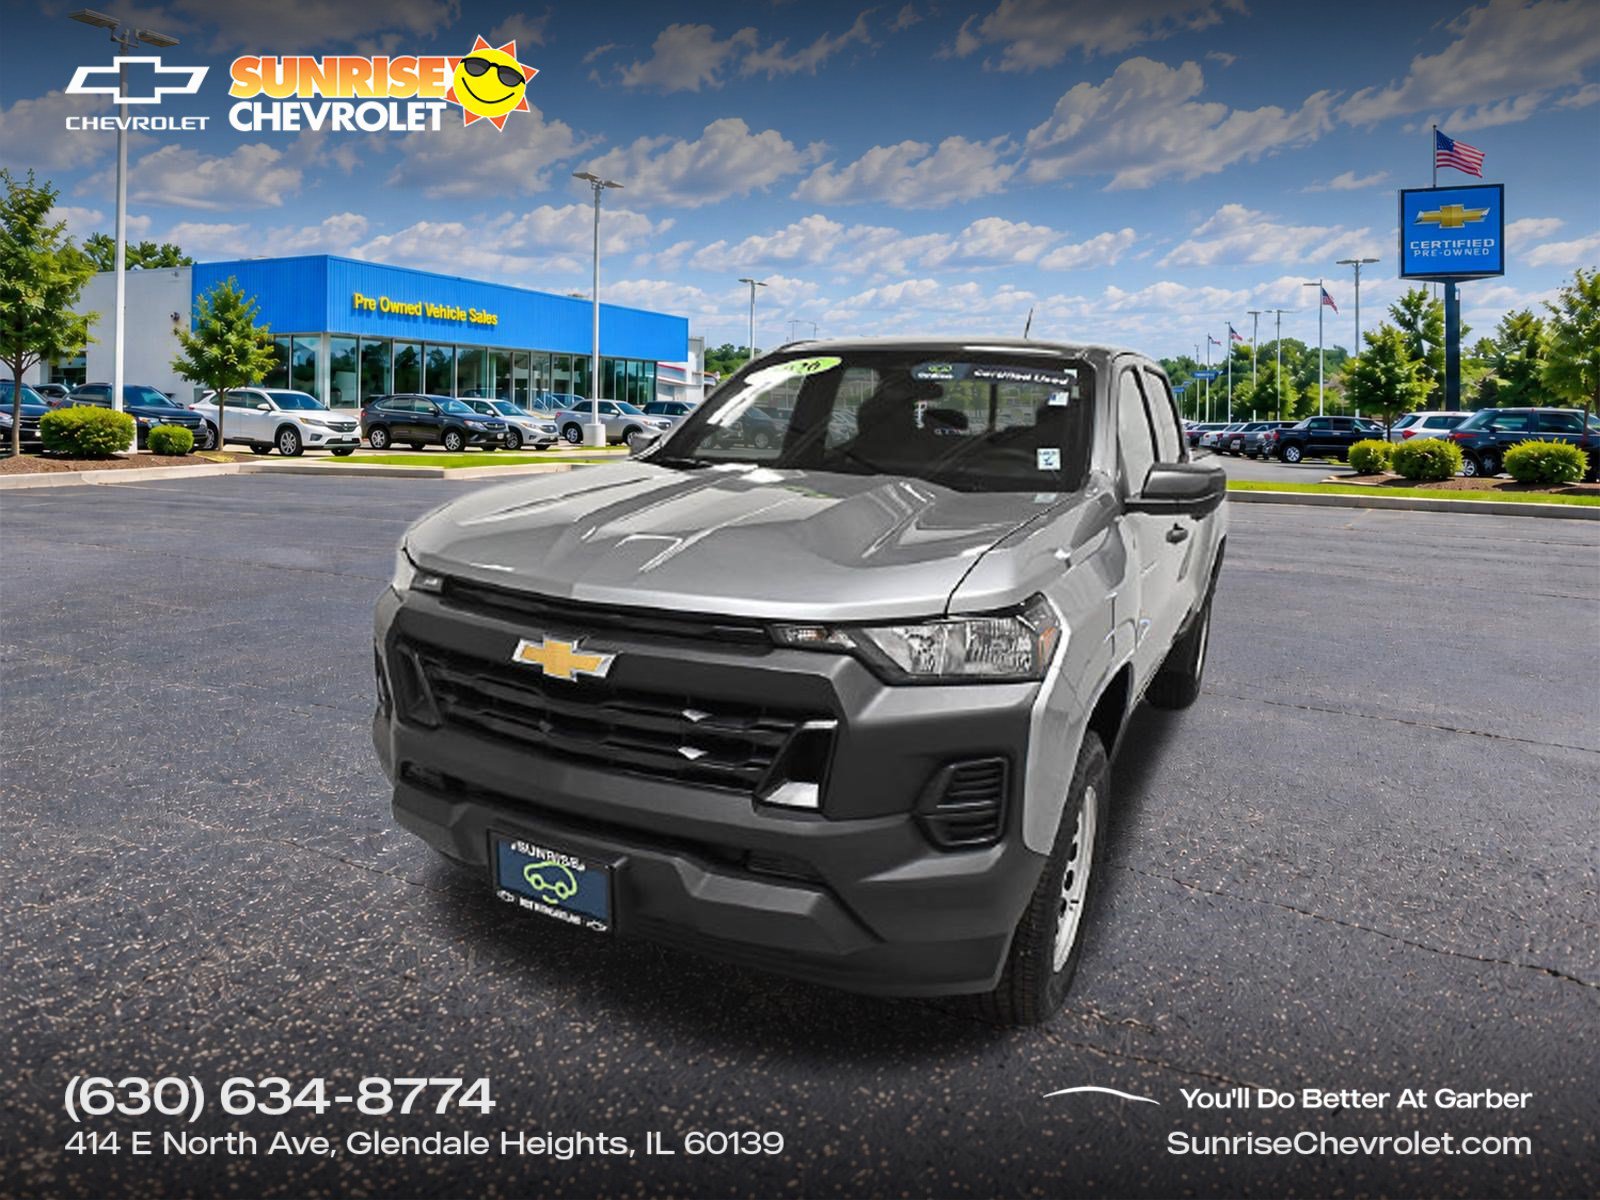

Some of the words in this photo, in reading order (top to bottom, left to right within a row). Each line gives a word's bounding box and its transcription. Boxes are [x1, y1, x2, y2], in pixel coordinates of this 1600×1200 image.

[1410, 239, 1495, 249] CERTIFIED
[1414, 248, 1490, 257] PRE-OWNED
[353, 292, 376, 310] Pre
[379, 296, 422, 316] Owned
[424, 302, 467, 321] Vehicle
[468, 308, 498, 325] Sales
